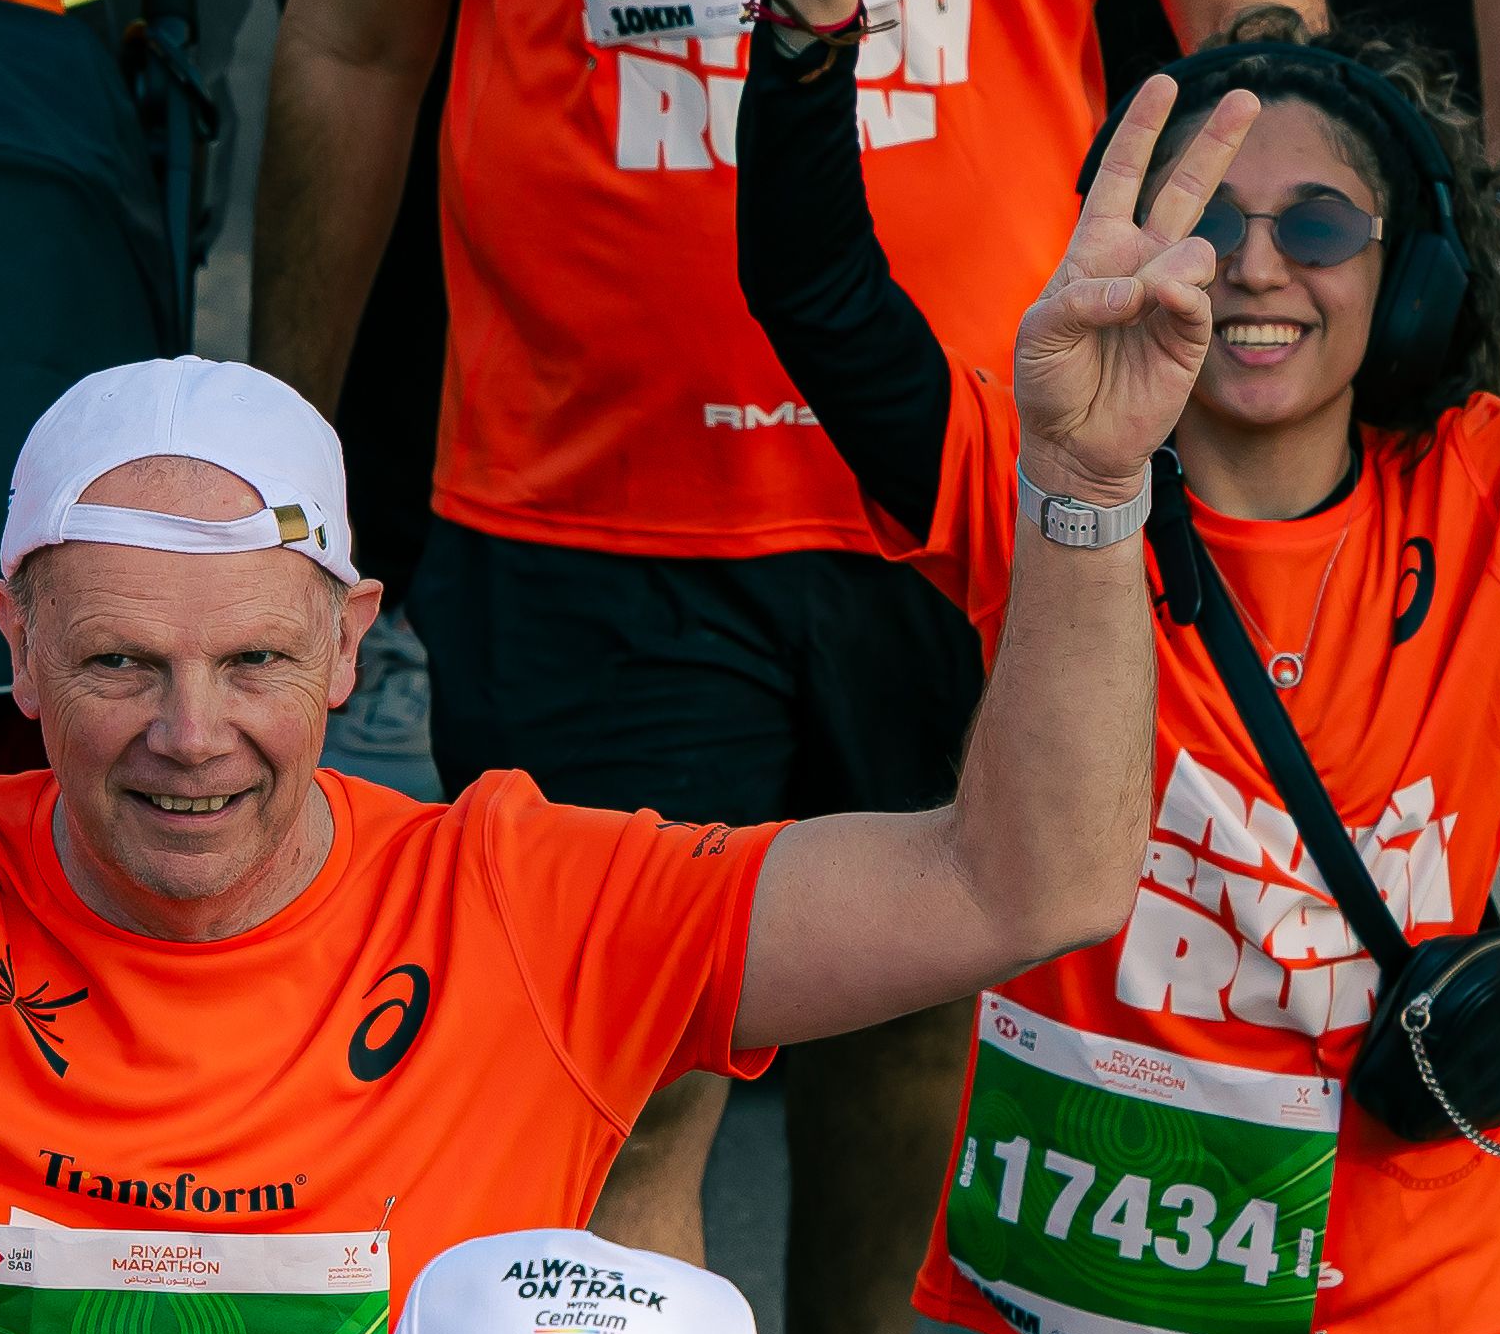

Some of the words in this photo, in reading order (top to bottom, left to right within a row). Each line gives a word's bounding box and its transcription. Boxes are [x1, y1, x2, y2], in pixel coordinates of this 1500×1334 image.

[610, 3, 695, 37] 10KM
[703, 401, 821, 431] RM2
[1093, 1058, 1187, 1092] MARATHON
[1111, 1049, 1174, 1075] RIYADH
[993, 1135, 1281, 1288] 17434
[130, 1244, 203, 1260] RIYADH
[6, 1259, 34, 1273] SAB
[112, 1258, 221, 1276] MARATHON
[501, 1257, 625, 1283] ALWAYS
[518, 1280, 562, 1300] ON
[569, 1279, 670, 1313] TRACK
[566, 1301, 600, 1310] WITH
[535, 1310, 628, 1332] Centrum
